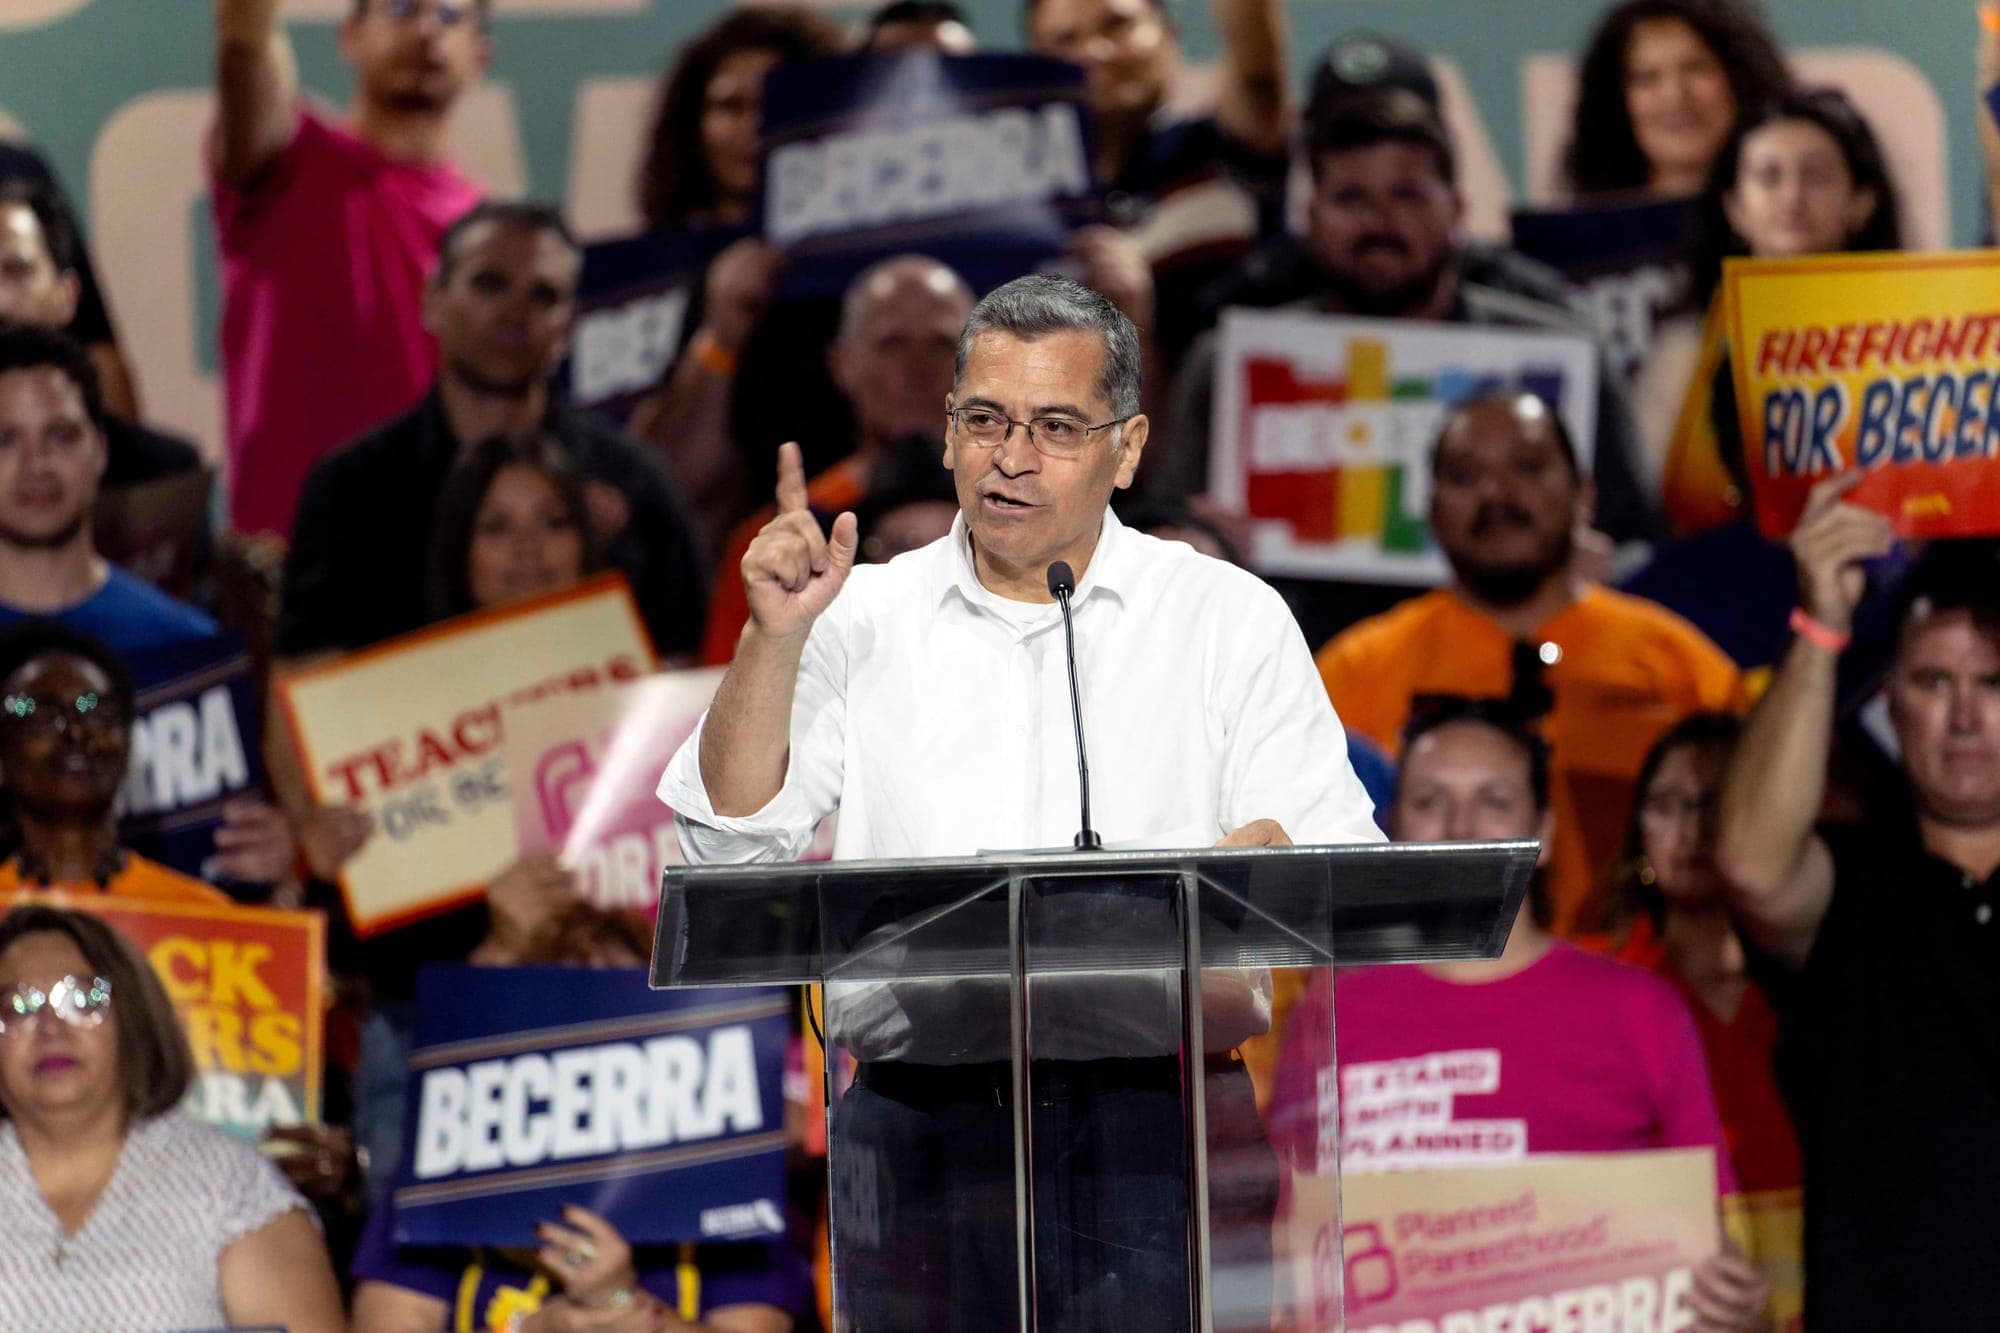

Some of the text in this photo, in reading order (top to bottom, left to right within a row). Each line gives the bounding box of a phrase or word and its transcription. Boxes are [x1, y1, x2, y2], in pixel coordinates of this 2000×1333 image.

[1758, 314, 2000, 378] FIREFIGHT
[1763, 384, 1853, 478] FOR
[180, 1072, 307, 1131] RA
[413, 1024, 764, 1180] BECERRA
[1395, 1188, 1538, 1241] Planned
[1402, 1213, 1610, 1277] Parenthood
